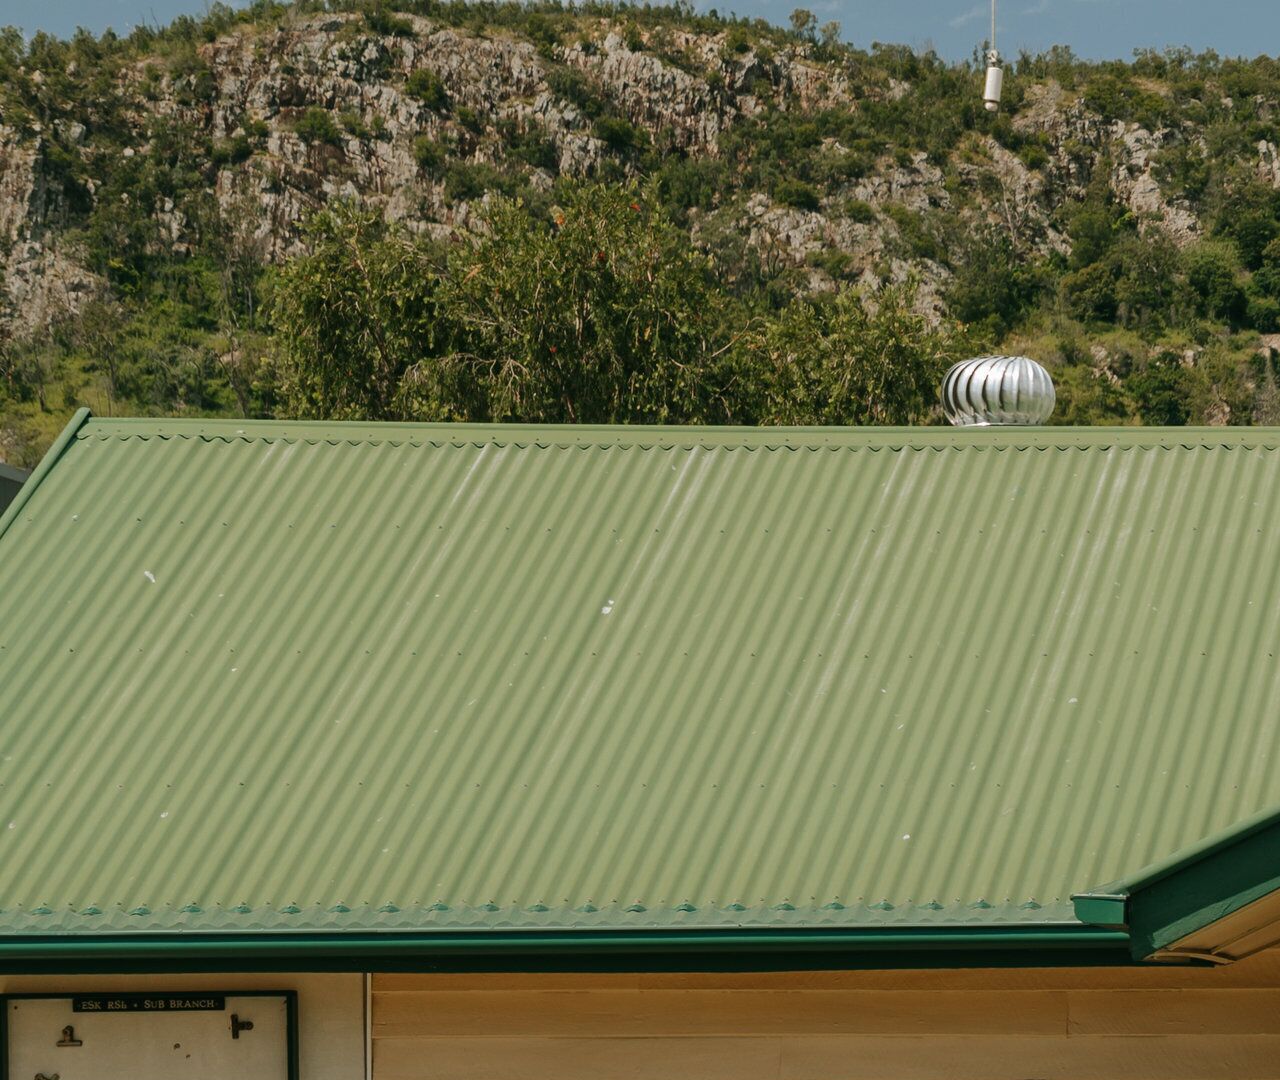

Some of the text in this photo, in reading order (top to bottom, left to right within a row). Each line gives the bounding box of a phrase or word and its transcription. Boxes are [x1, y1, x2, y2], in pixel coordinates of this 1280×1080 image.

[81, 999, 216, 1010] ESK RSL SUB BRANCH
